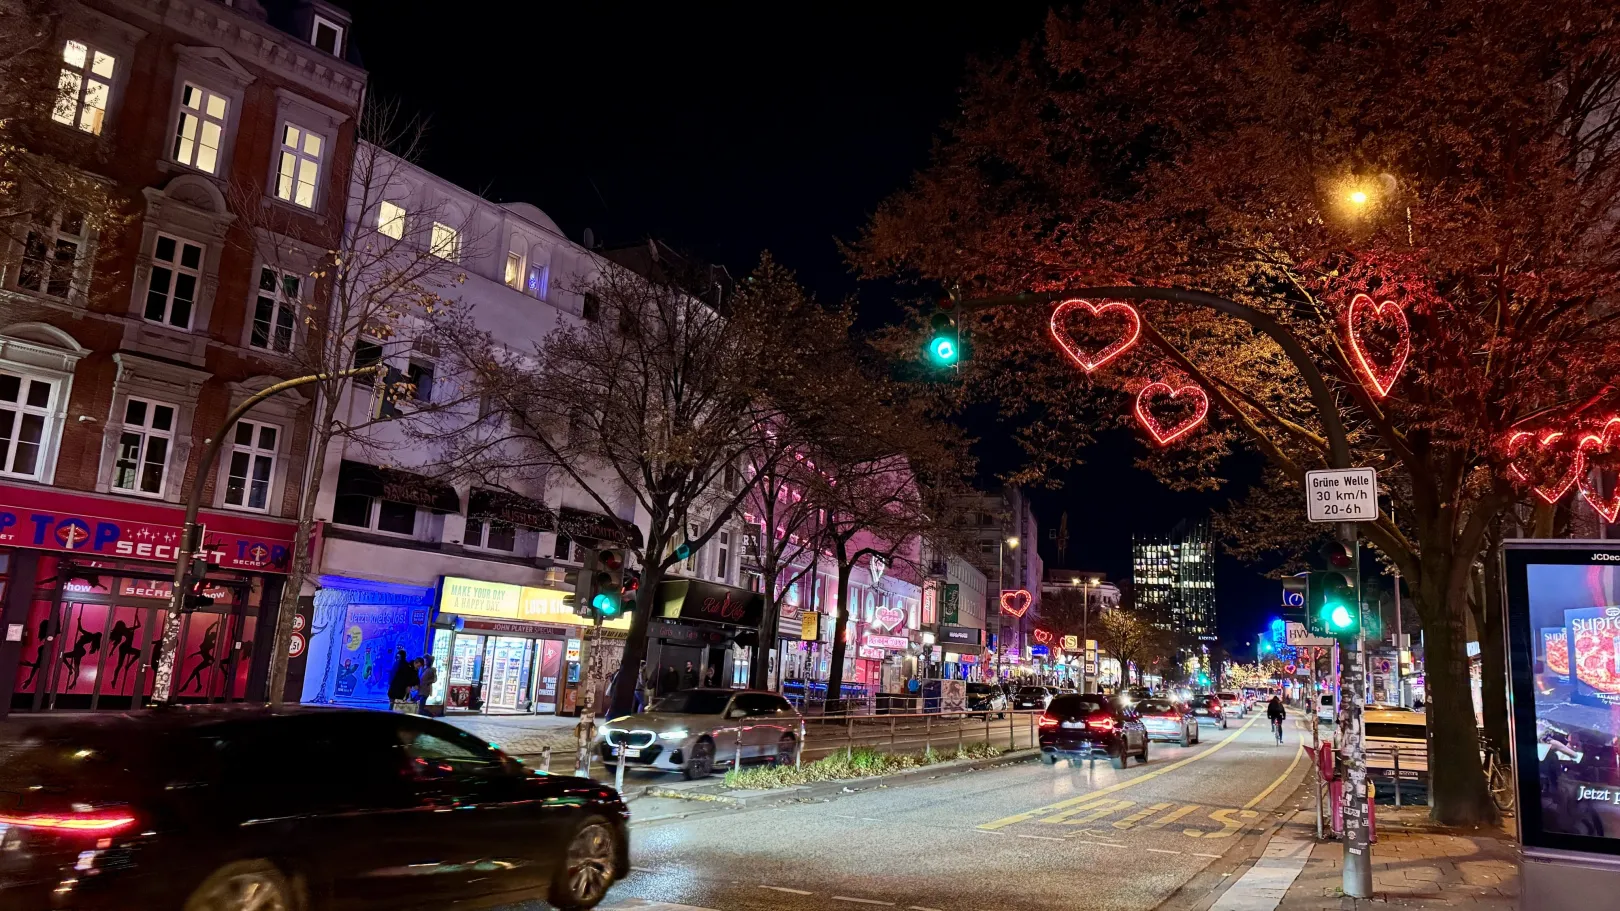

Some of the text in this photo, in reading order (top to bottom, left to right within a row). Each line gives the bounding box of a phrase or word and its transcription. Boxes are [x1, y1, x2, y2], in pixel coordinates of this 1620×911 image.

[1312, 475, 1369, 488] Grüne Welle
[1316, 489, 1368, 501] 30 km/h
[30, 513, 121, 551] TOP
[115, 540, 226, 564] SECET
[125, 586, 173, 599] SECRE
[451, 584, 506, 601] MAKE YOUR DAY
[453, 597, 459, 608] A
[461, 598, 485, 611] HAPPY
[348, 611, 369, 624] Jetzt
[392, 611, 407, 624] los!
[492, 624, 555, 635] JOHN PLAYER SPECIAL
[1577, 785, 1611, 801] Jetzt
